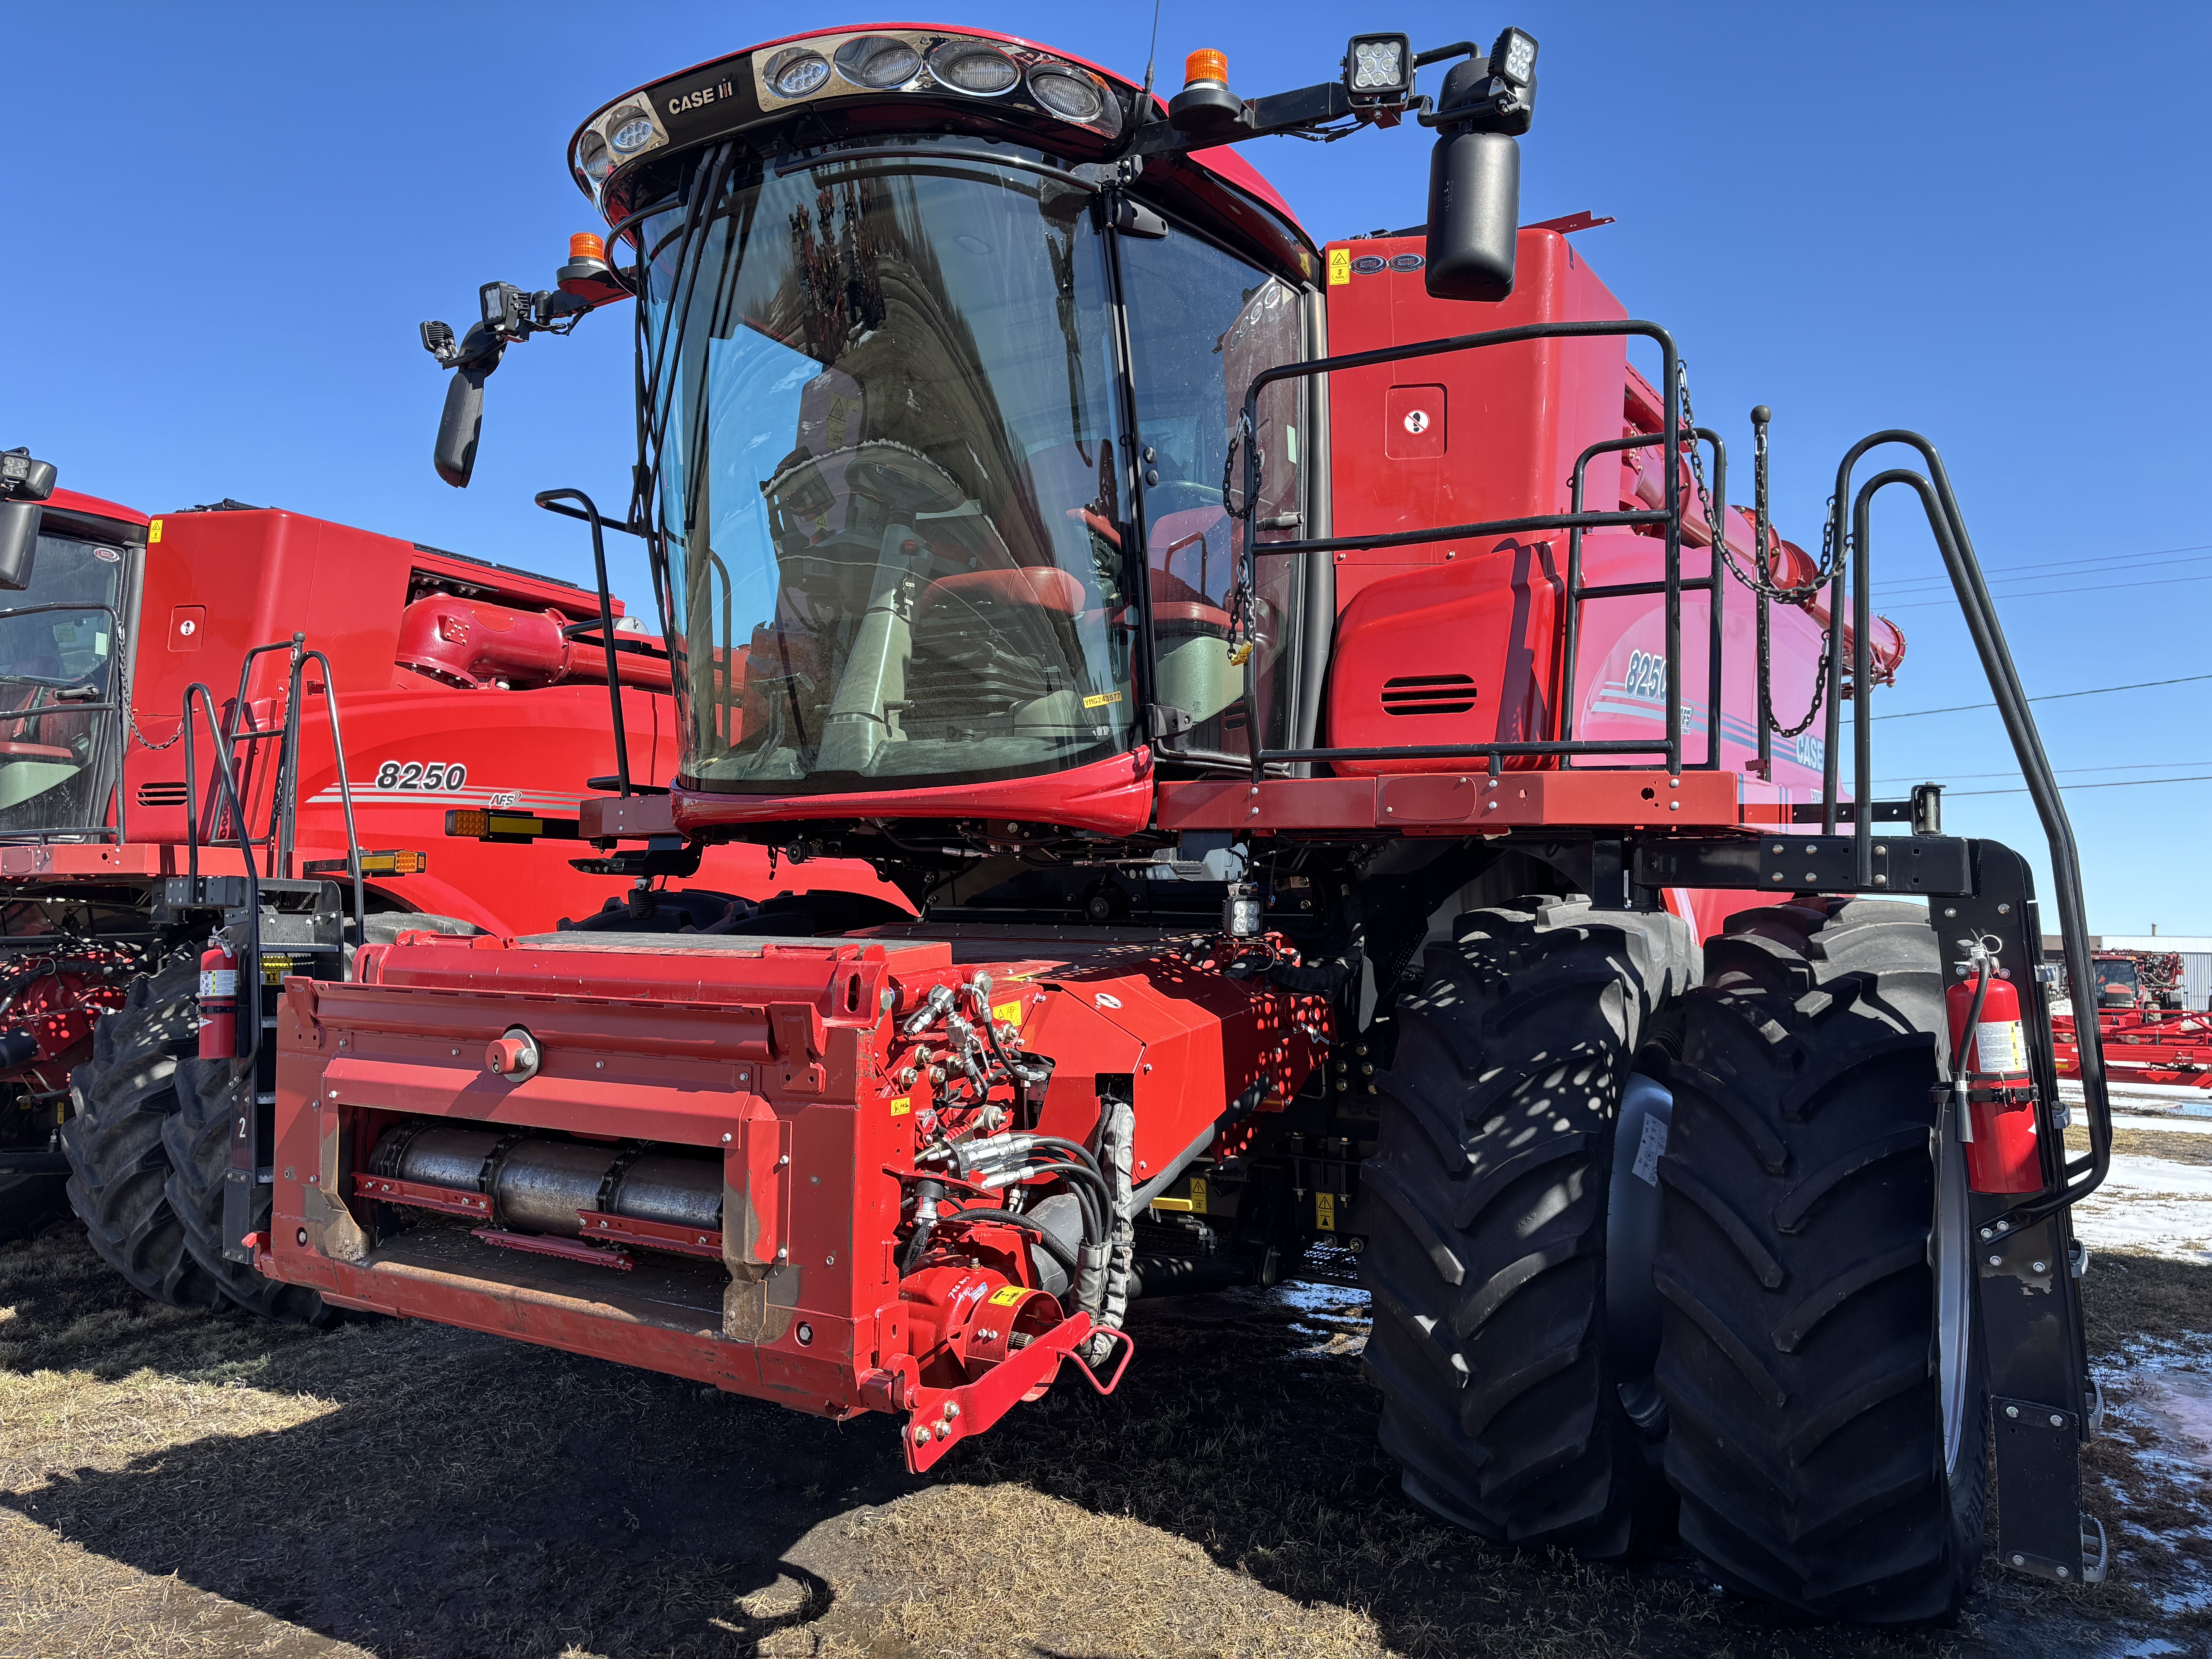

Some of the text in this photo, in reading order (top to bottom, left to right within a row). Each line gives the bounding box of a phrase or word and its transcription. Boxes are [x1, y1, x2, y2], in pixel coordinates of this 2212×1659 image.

[669, 88, 714, 114] CASE
[1084, 693, 1120, 705] YMG243577
[1796, 733, 1823, 771] CASE
[375, 761, 467, 792] 8250
[489, 793, 516, 806] AFS
[239, 1117, 246, 1138] 2
